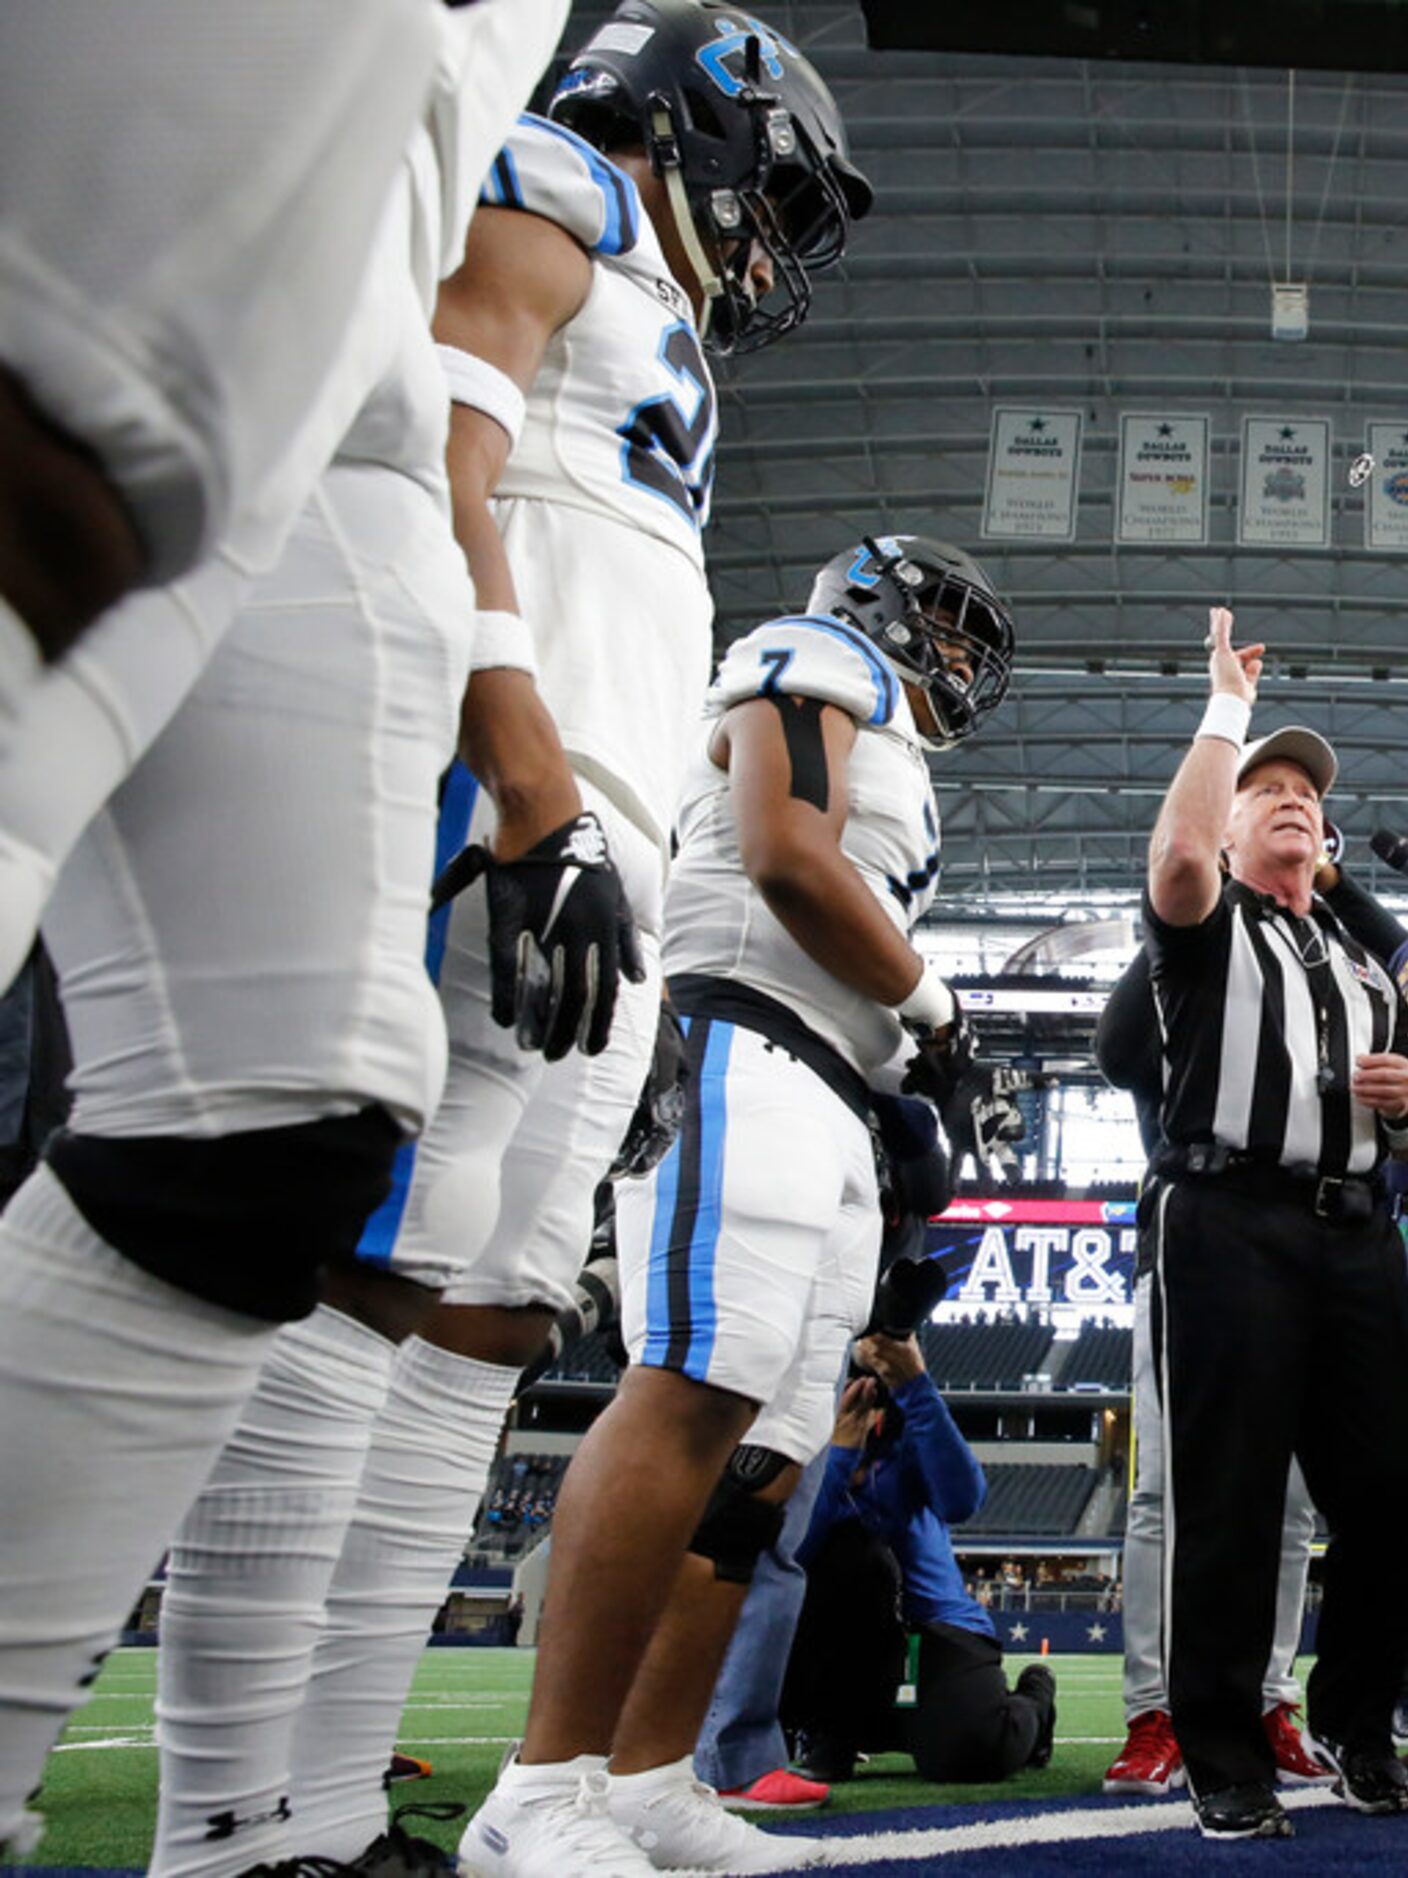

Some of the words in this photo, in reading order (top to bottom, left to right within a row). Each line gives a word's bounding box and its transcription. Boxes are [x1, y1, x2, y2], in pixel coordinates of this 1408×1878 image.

[1014, 436, 1059, 446] DALLAS
[1142, 441, 1187, 452] DALLAS
[1007, 447, 1063, 458] COWBOYS
[1264, 445, 1308, 454] DALLAS
[1136, 452, 1192, 462] COWBOYS
[1258, 454, 1313, 465] COWBOYS
[757, 649, 796, 697] 7
